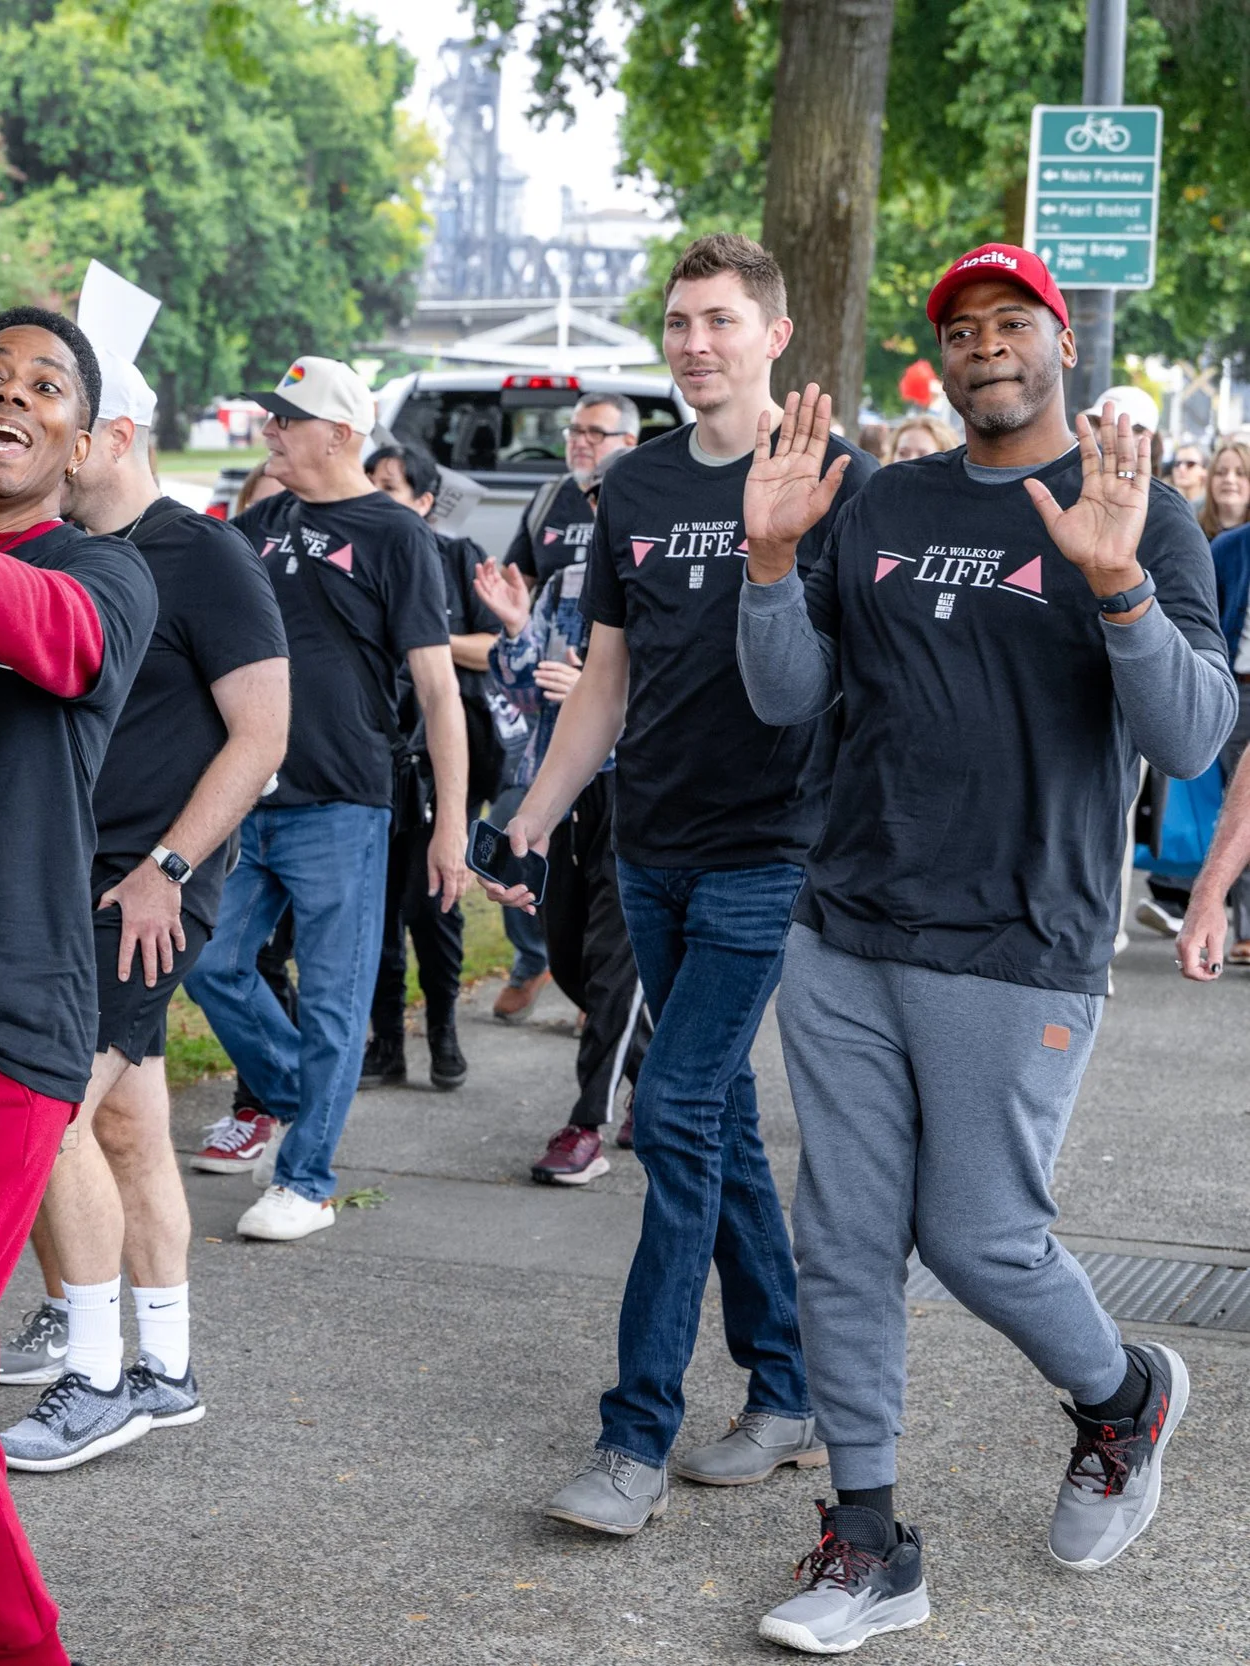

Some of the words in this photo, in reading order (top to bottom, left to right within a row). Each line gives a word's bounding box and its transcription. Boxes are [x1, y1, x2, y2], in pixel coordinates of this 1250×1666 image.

[563, 528, 595, 545] LIF
[671, 523, 690, 533] ALL
[691, 521, 723, 531] WALKS
[724, 520, 738, 530] OF
[278, 532, 328, 558] LFE
[665, 531, 734, 558] LIFE
[925, 545, 948, 556] ALL
[949, 547, 986, 559] WALKS
[987, 549, 1005, 560] OF
[913, 555, 999, 588] LIFE
